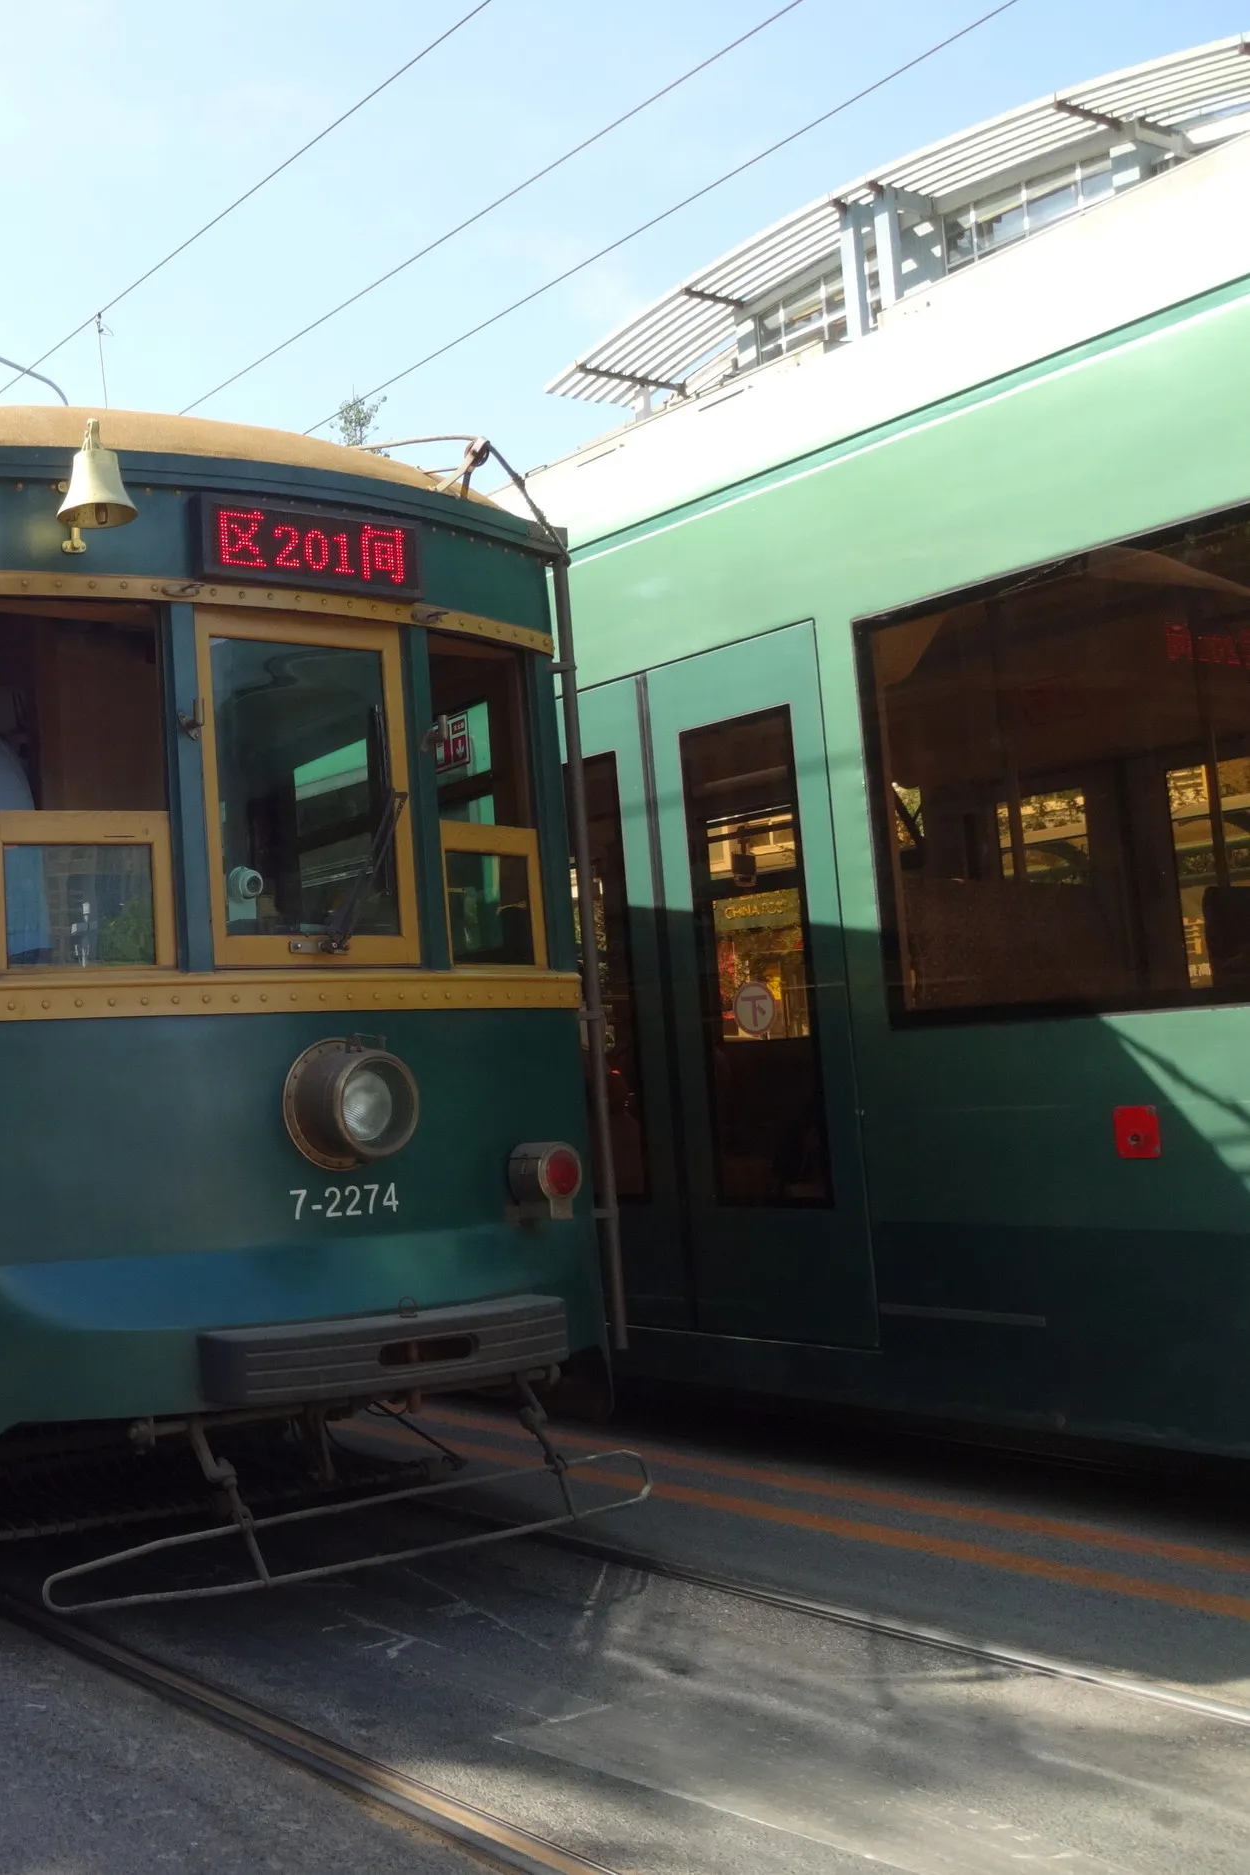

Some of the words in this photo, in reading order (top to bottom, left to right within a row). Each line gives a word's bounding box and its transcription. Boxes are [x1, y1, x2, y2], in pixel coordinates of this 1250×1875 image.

[217, 511, 405, 584] 区201间
[724, 904, 760, 919] CHINA
[740, 995, 767, 1027] 下
[289, 1182, 399, 1220] 7-2274
